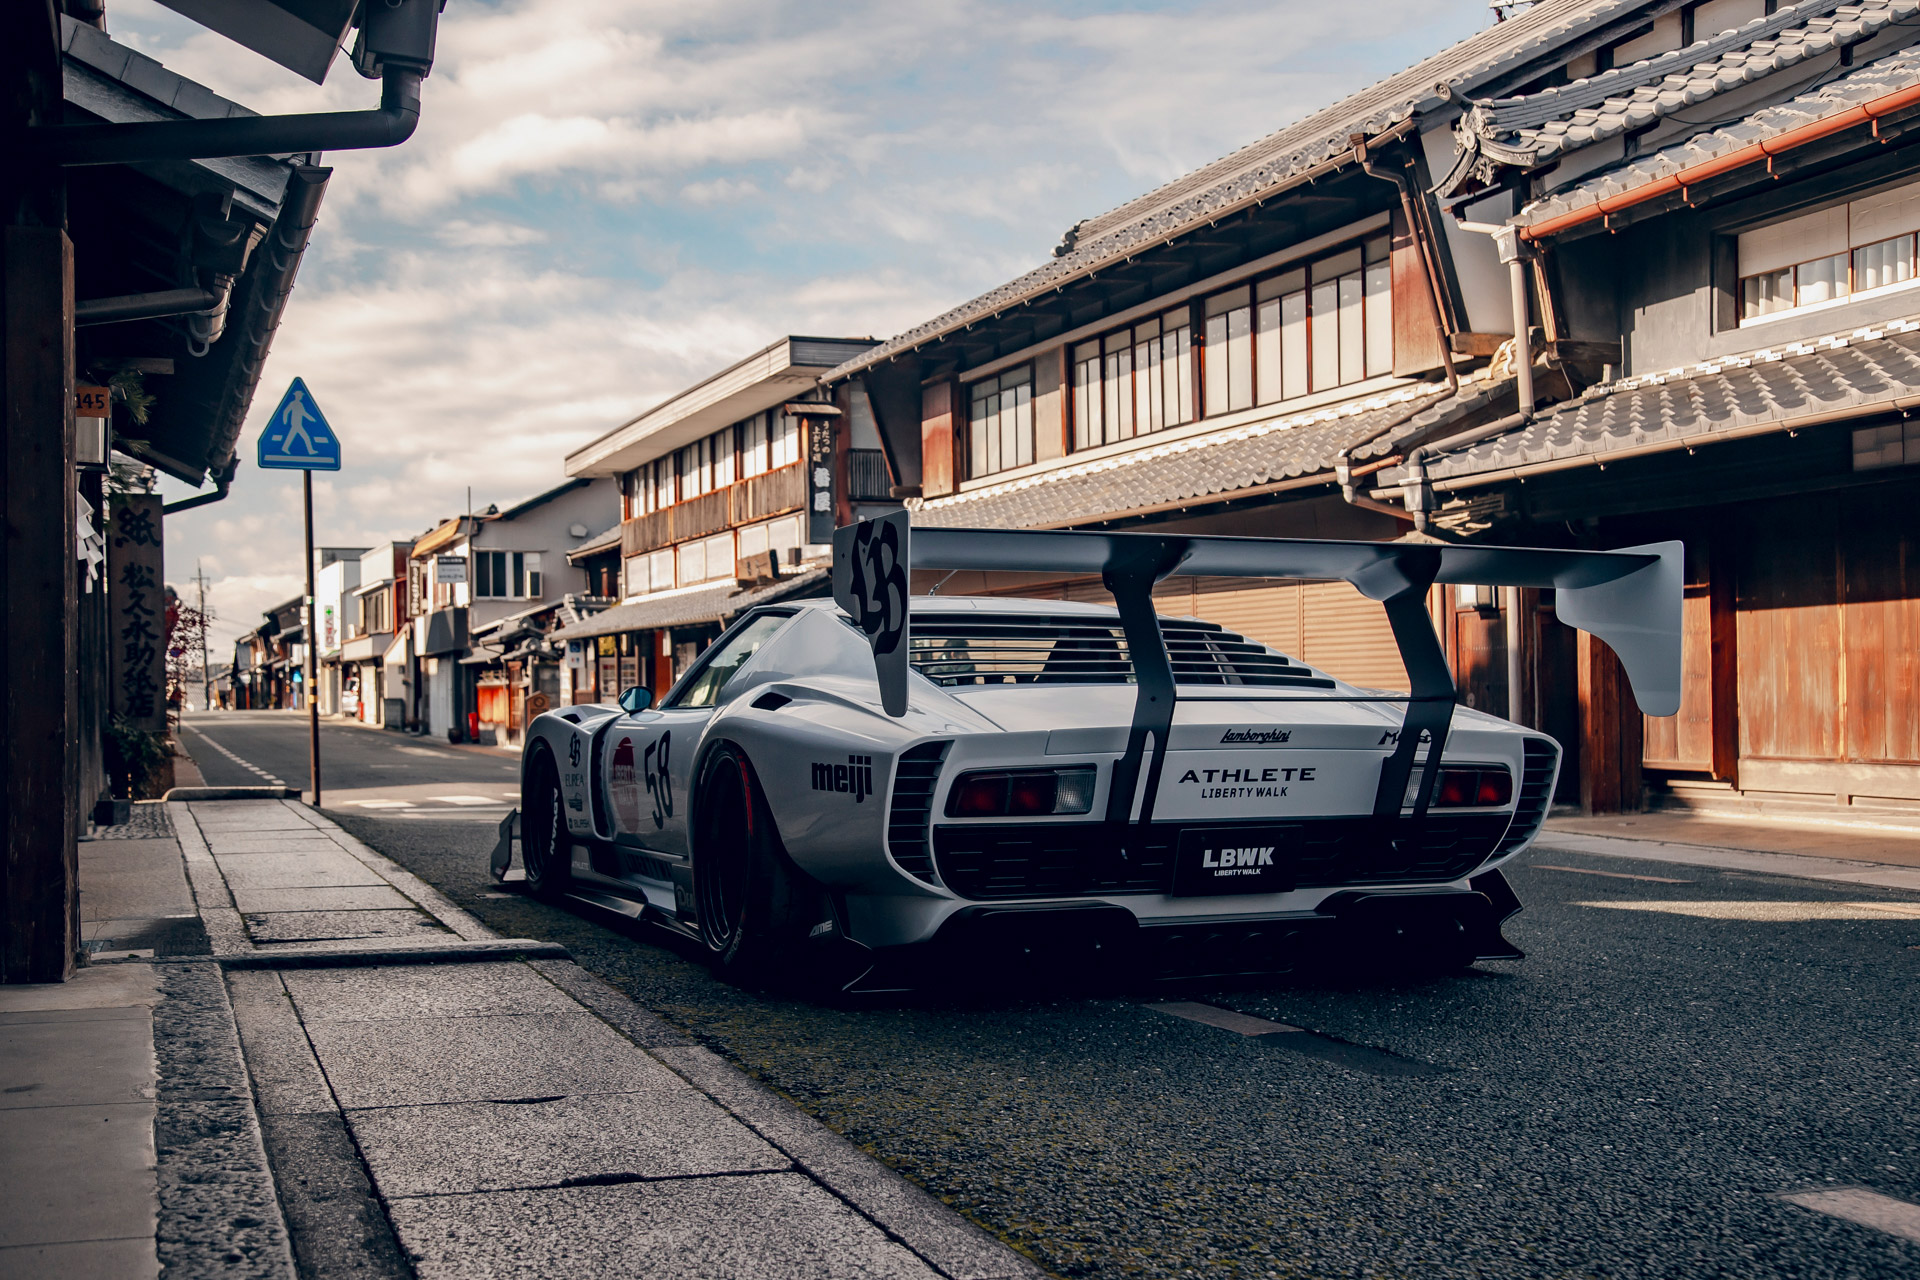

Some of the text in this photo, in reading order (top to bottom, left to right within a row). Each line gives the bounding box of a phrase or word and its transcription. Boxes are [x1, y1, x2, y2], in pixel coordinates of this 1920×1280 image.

[644, 730, 673, 830] 58
[812, 755, 873, 803] meiji
[1178, 768, 1316, 783] ATHLETE
[1201, 786, 1288, 799] LIBERTY WALK
[549, 787, 559, 855] ADVAN
[1202, 846, 1275, 868] LBWK
[1214, 869, 1241, 877] LIBERTY
